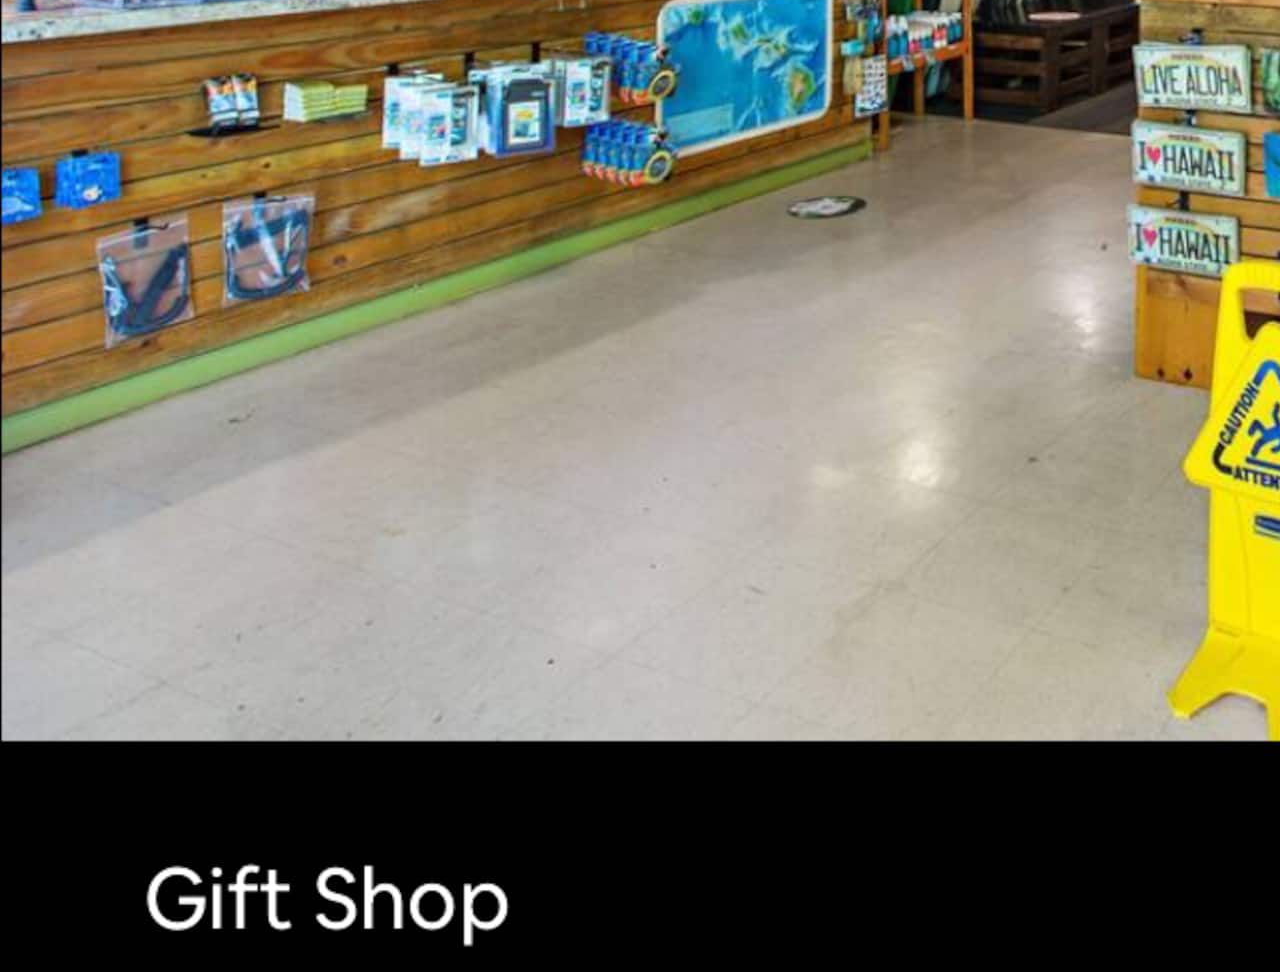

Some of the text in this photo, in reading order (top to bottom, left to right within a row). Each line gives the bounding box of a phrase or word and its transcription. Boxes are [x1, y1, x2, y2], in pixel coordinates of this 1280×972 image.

[1140, 64, 1243, 96] LIVE ALOHA
[1137, 140, 1235, 182] I HAWAII
[1135, 222, 1232, 265] I HAWAII
[1219, 382, 1259, 446] CAUTION
